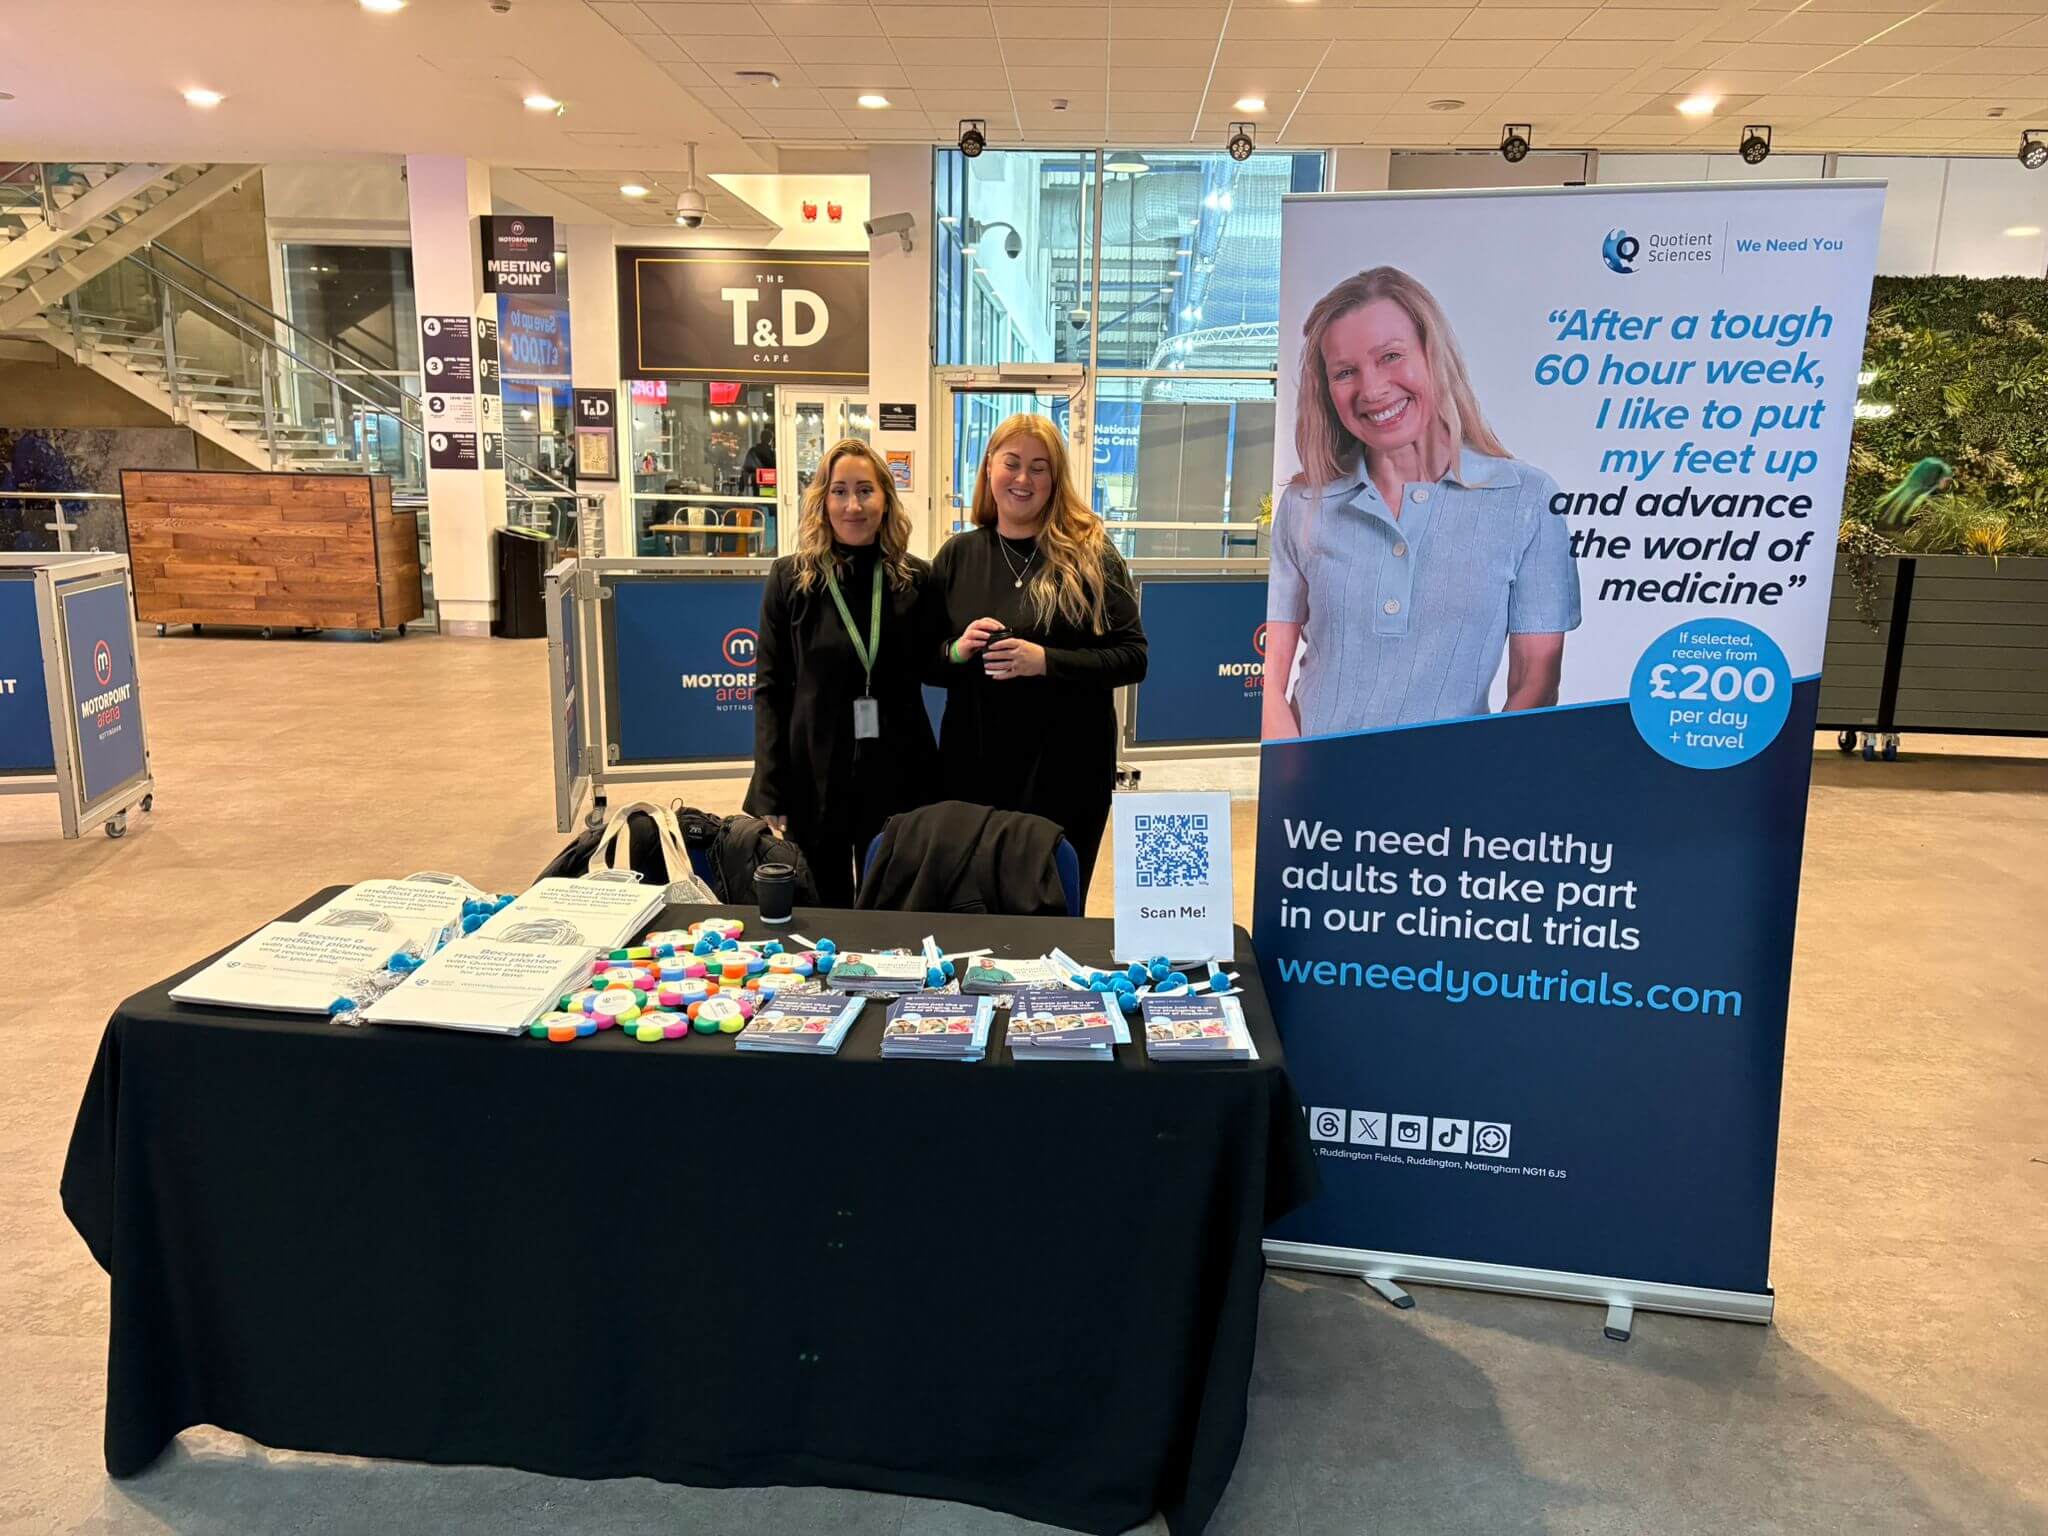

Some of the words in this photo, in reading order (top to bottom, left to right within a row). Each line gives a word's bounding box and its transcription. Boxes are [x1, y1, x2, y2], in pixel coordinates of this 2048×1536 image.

[1649, 233, 1713, 247] Quotient
[1736, 239, 1761, 252] We
[1766, 238, 1808, 252] Need
[1812, 237, 1844, 251] You
[1648, 248, 1712, 263] Sciences
[488, 260, 552, 273] MEETING
[498, 274, 542, 286] POINT
[756, 275, 784, 283] THE
[721, 288, 829, 347] T&D
[1670, 316, 1699, 341] a
[1710, 305, 1834, 347] tough
[1533, 353, 1590, 386] 60
[1597, 353, 1696, 386] hour
[1706, 351, 1825, 389] week,
[580, 400, 609, 416] T&D
[1595, 398, 1612, 430] I
[1617, 396, 1689, 430] like
[1702, 399, 1742, 430] to
[1749, 399, 1826, 438] put
[1094, 424, 1140, 435] National
[1094, 436, 1110, 445] Ice
[1599, 448, 1665, 482] my
[1672, 442, 1756, 475] feet
[1764, 449, 1818, 482] up
[1548, 485, 1628, 517] and
[1635, 486, 1813, 519] advance
[1569, 528, 1631, 559] the
[1643, 530, 1760, 562] world
[1767, 531, 1815, 562] of
[1679, 632, 1690, 644] If
[1691, 633, 1753, 647] selected,
[1672, 648, 1722, 660] receive
[1726, 649, 1758, 661] from
[1218, 663, 1265, 676] MOTO
[1649, 663, 1776, 703] £200
[81, 683, 130, 719] MOTORPOINT
[96, 705, 120, 728] arena
[1670, 709, 1703, 727] per
[1708, 708, 1748, 730] day
[1686, 731, 1744, 749] travel
[1283, 818, 1343, 853] We
[1354, 826, 1451, 858] need
[1463, 827, 1613, 874] healthy
[1281, 862, 1398, 894] adults
[1409, 867, 1447, 898] to
[1458, 871, 1544, 903] take
[1555, 879, 1637, 912] part
[1140, 906, 1176, 919] Scan
[1180, 906, 1206, 918] Me!
[1280, 898, 1311, 930] in
[1323, 906, 1386, 934] our
[1395, 905, 1532, 944] clinical
[1543, 915, 1641, 951] trials
[272, 936, 325, 945] medical
[326, 942, 377, 952] pioneer
[298, 932, 352, 942] Become
[454, 953, 507, 961] medical
[480, 949, 534, 958] Become
[1276, 957, 1743, 1017] weneedyoutrials.com
[1320, 1148, 1372, 1160] Ruddington
[1374, 1153, 1404, 1164] Fields,
[1406, 1156, 1462, 1169] Ruddington,
[1465, 1161, 1520, 1174] Nottingham
[1522, 1167, 1546, 1176] NG11
[1548, 1169, 1567, 1178] 6JS
